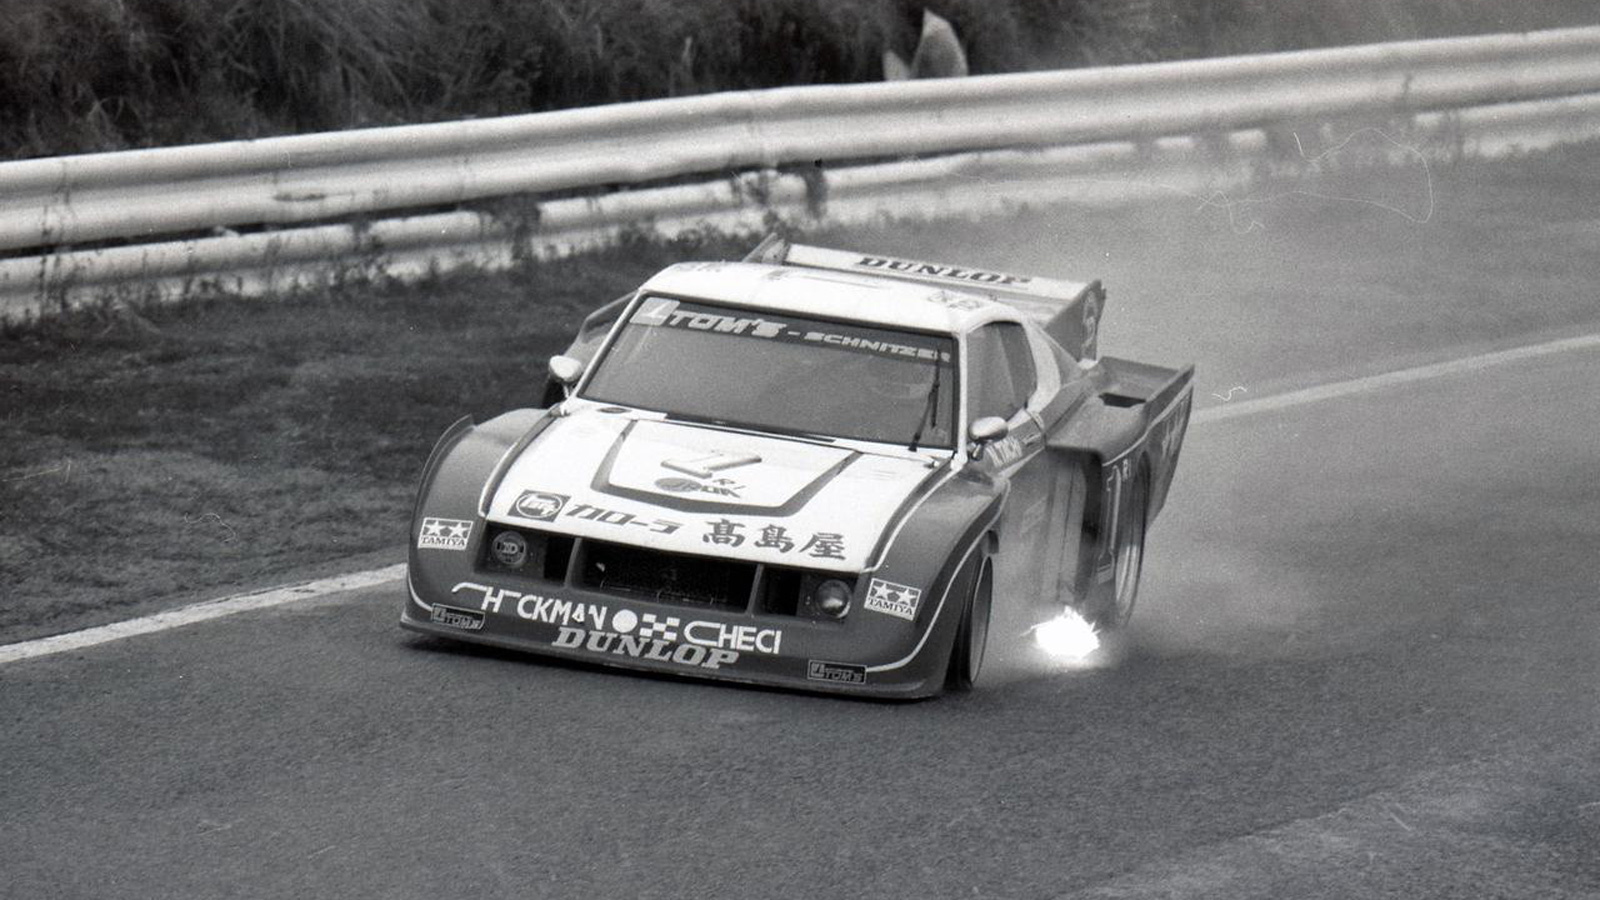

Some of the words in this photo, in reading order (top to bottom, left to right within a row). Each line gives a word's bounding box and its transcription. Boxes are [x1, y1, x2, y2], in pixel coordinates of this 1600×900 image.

[858, 256, 1032, 285] DUNLOP
[669, 309, 788, 339] TOM'S
[803, 331, 951, 363] SCHNITZER
[565, 503, 685, 535] カローラ
[421, 536, 466, 547] TAMIYA
[868, 598, 913, 616] TAMIYA
[550, 626, 740, 670] DUNLOP
